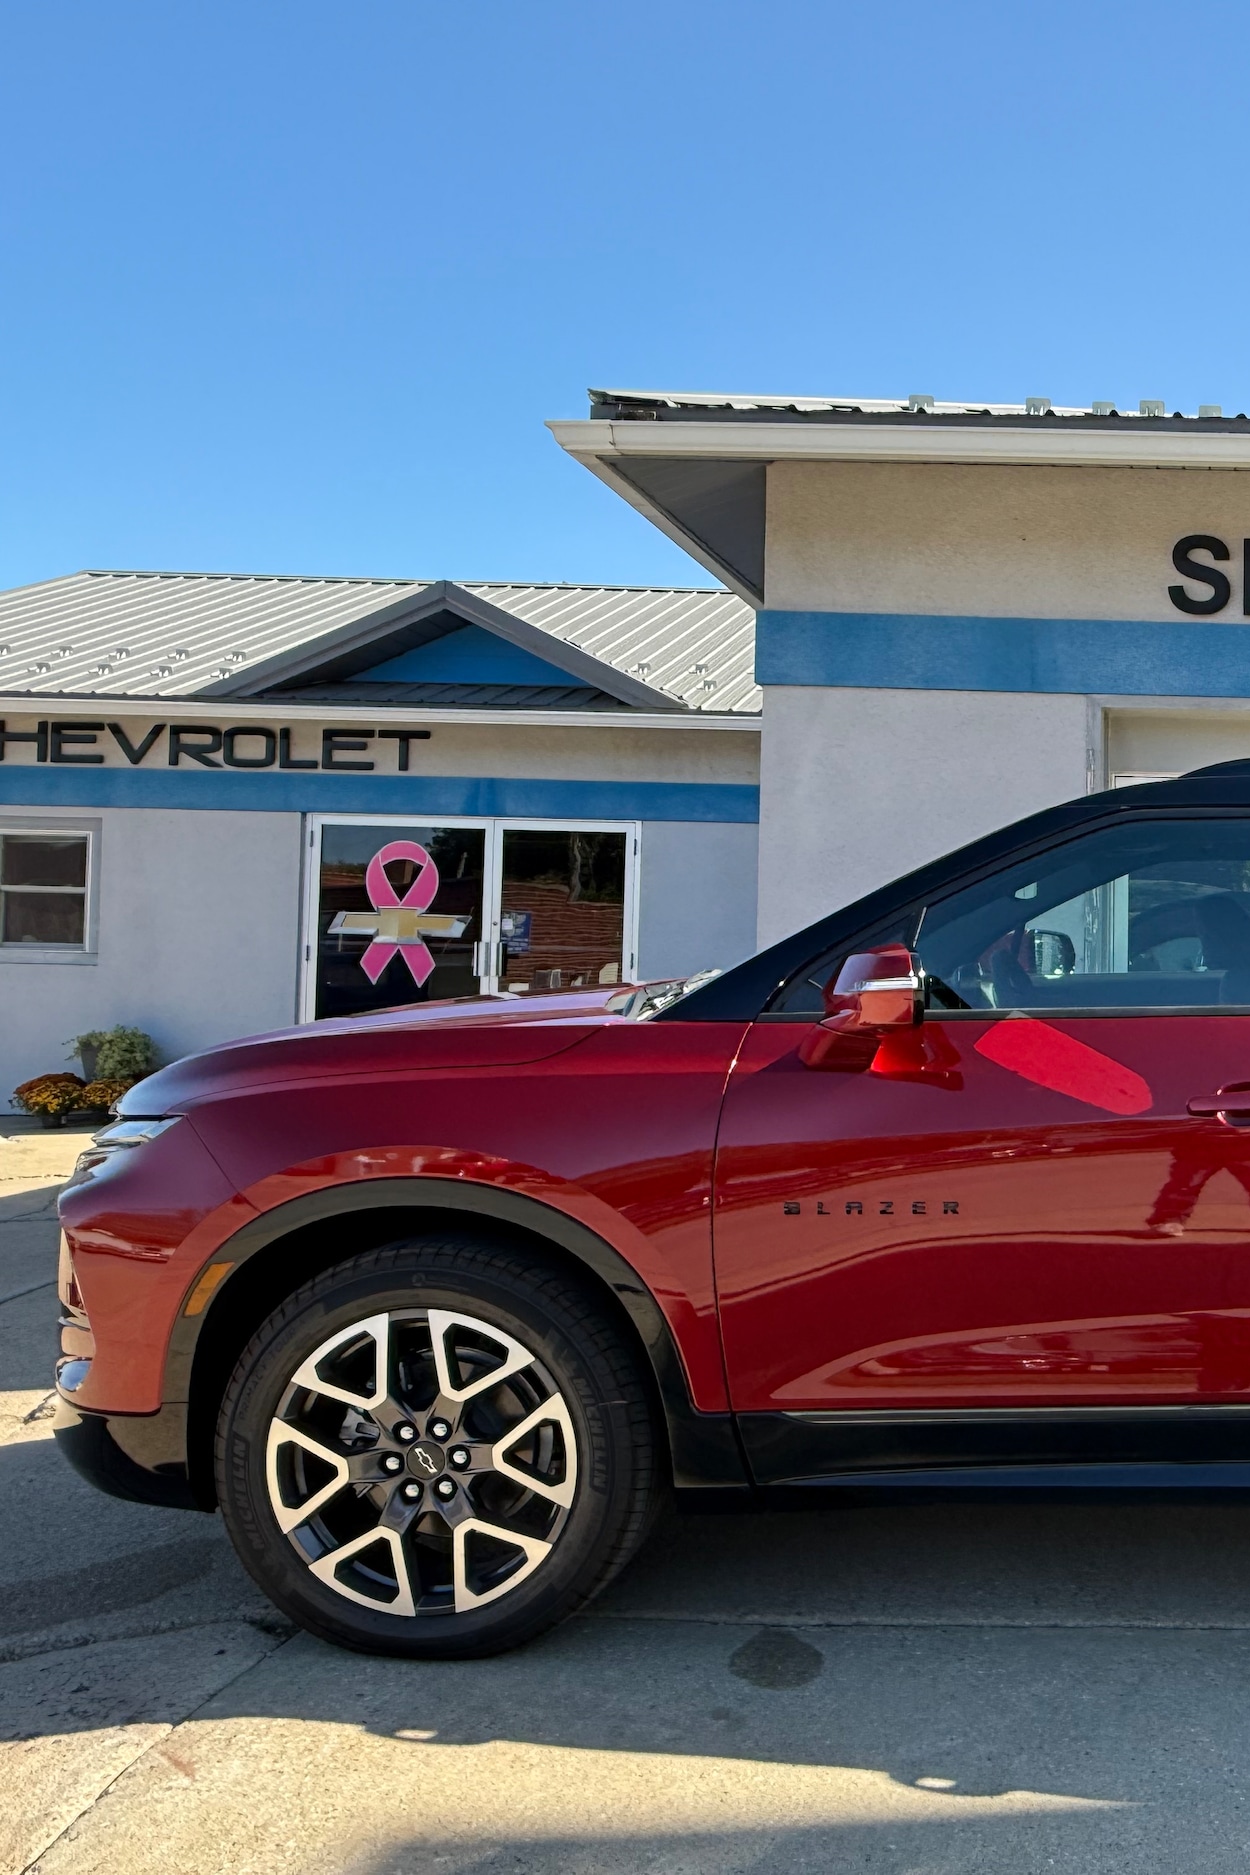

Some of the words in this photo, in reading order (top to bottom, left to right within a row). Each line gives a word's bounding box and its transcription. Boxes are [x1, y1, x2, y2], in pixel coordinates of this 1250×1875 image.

[0, 720, 431, 771] HEVROLET
[783, 1201, 959, 1215] BLAZER
[572, 1377, 609, 1491] MICHELIN
[230, 1435, 266, 1551] MICHELIN
